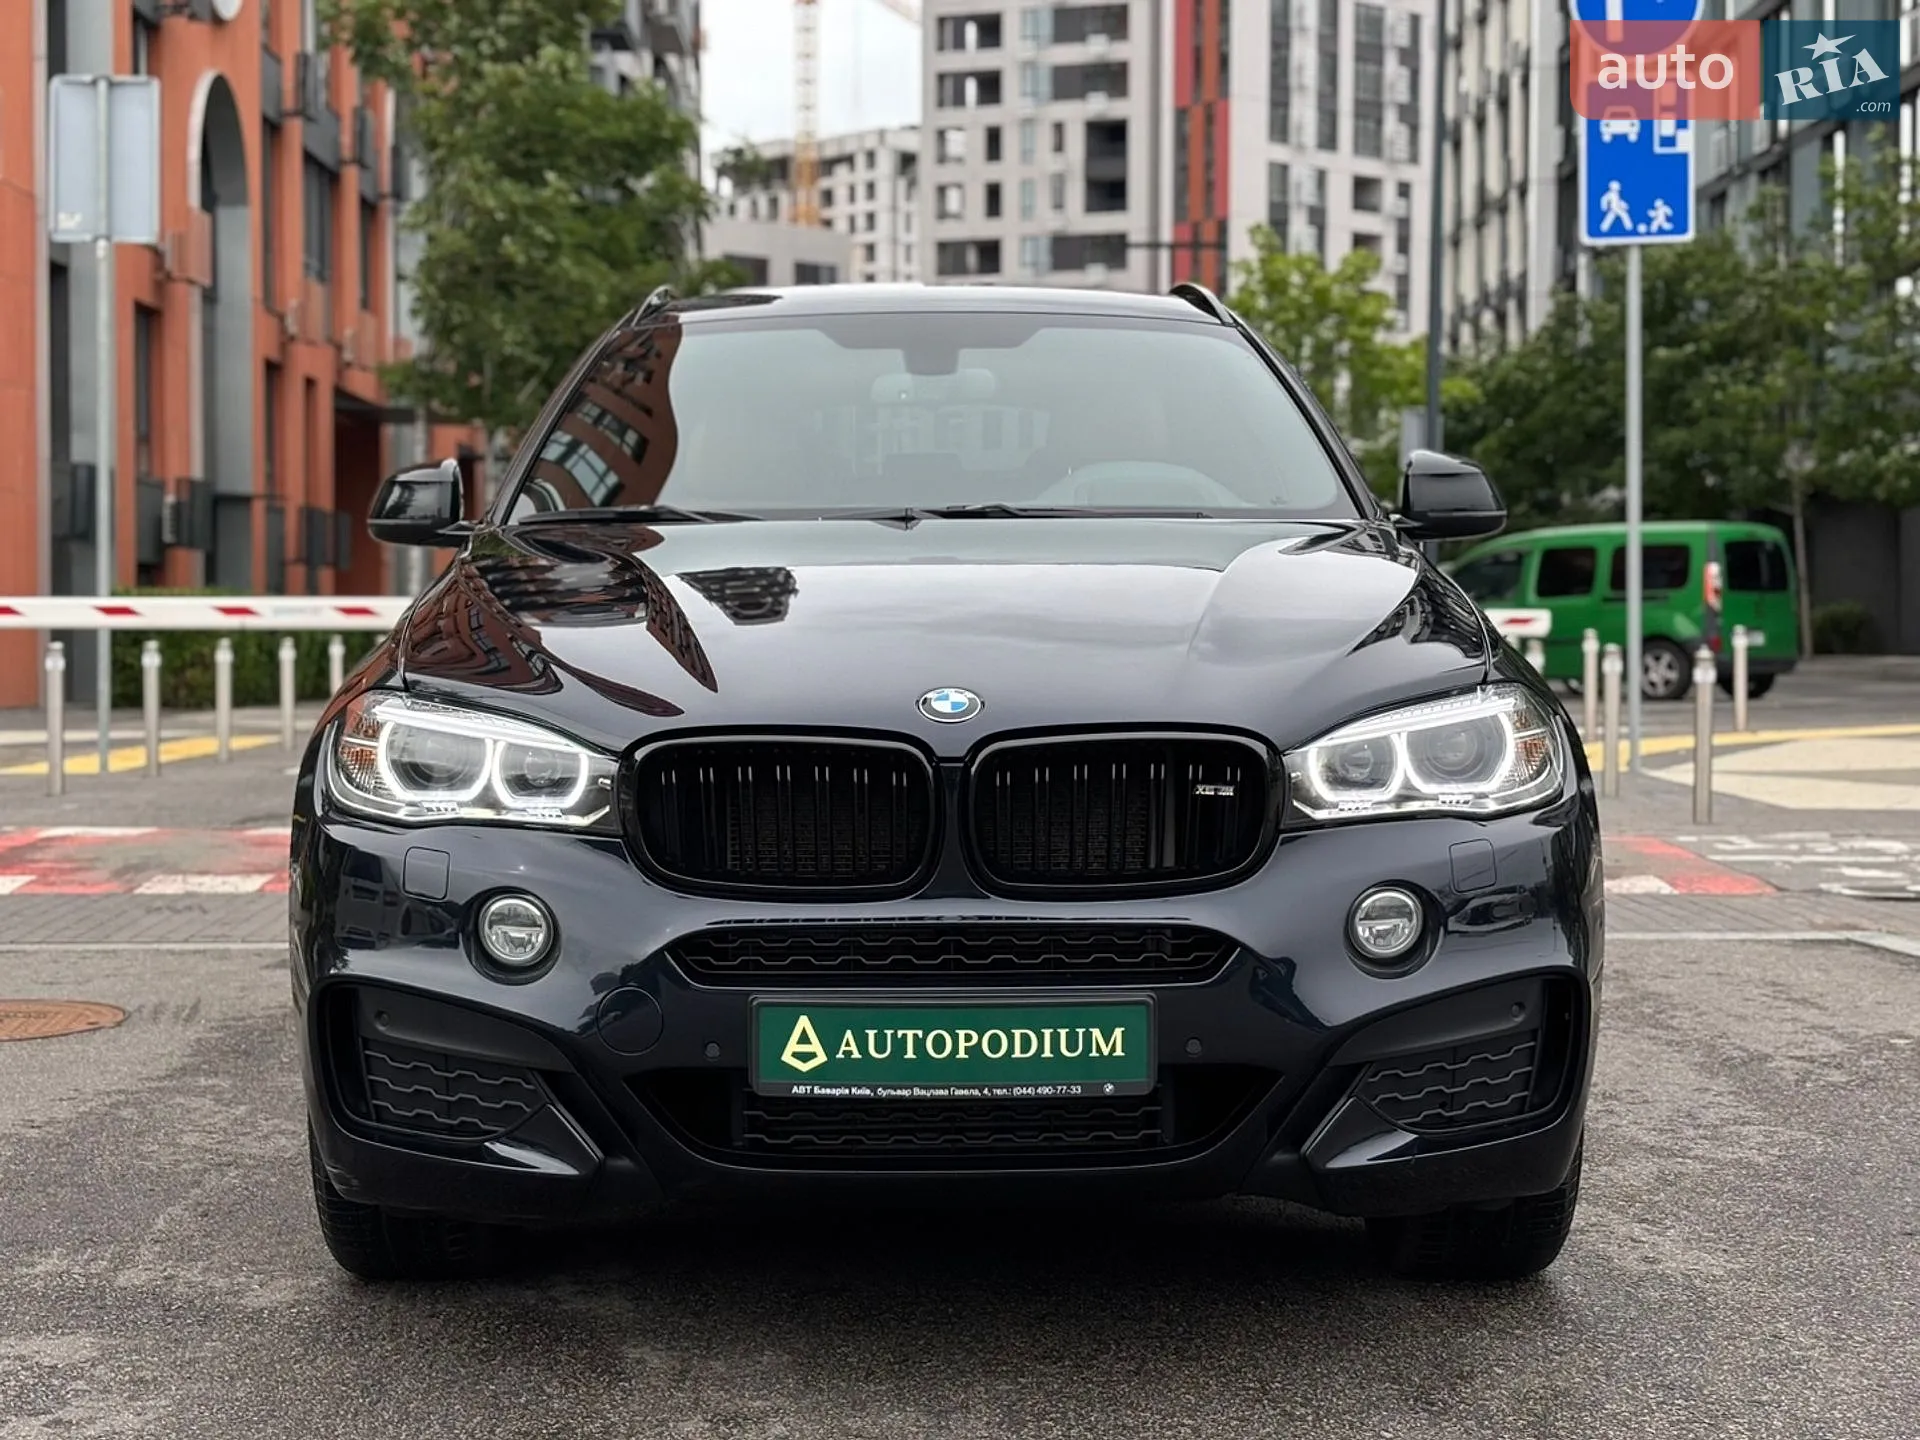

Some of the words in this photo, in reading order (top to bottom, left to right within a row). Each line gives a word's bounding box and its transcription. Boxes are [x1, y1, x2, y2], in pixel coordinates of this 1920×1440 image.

[836, 1027, 1126, 1060] AUTOPODIUM
[1012, 1085, 1035, 1097] (044)
[1036, 1084, 1082, 1096] 490-77-33
